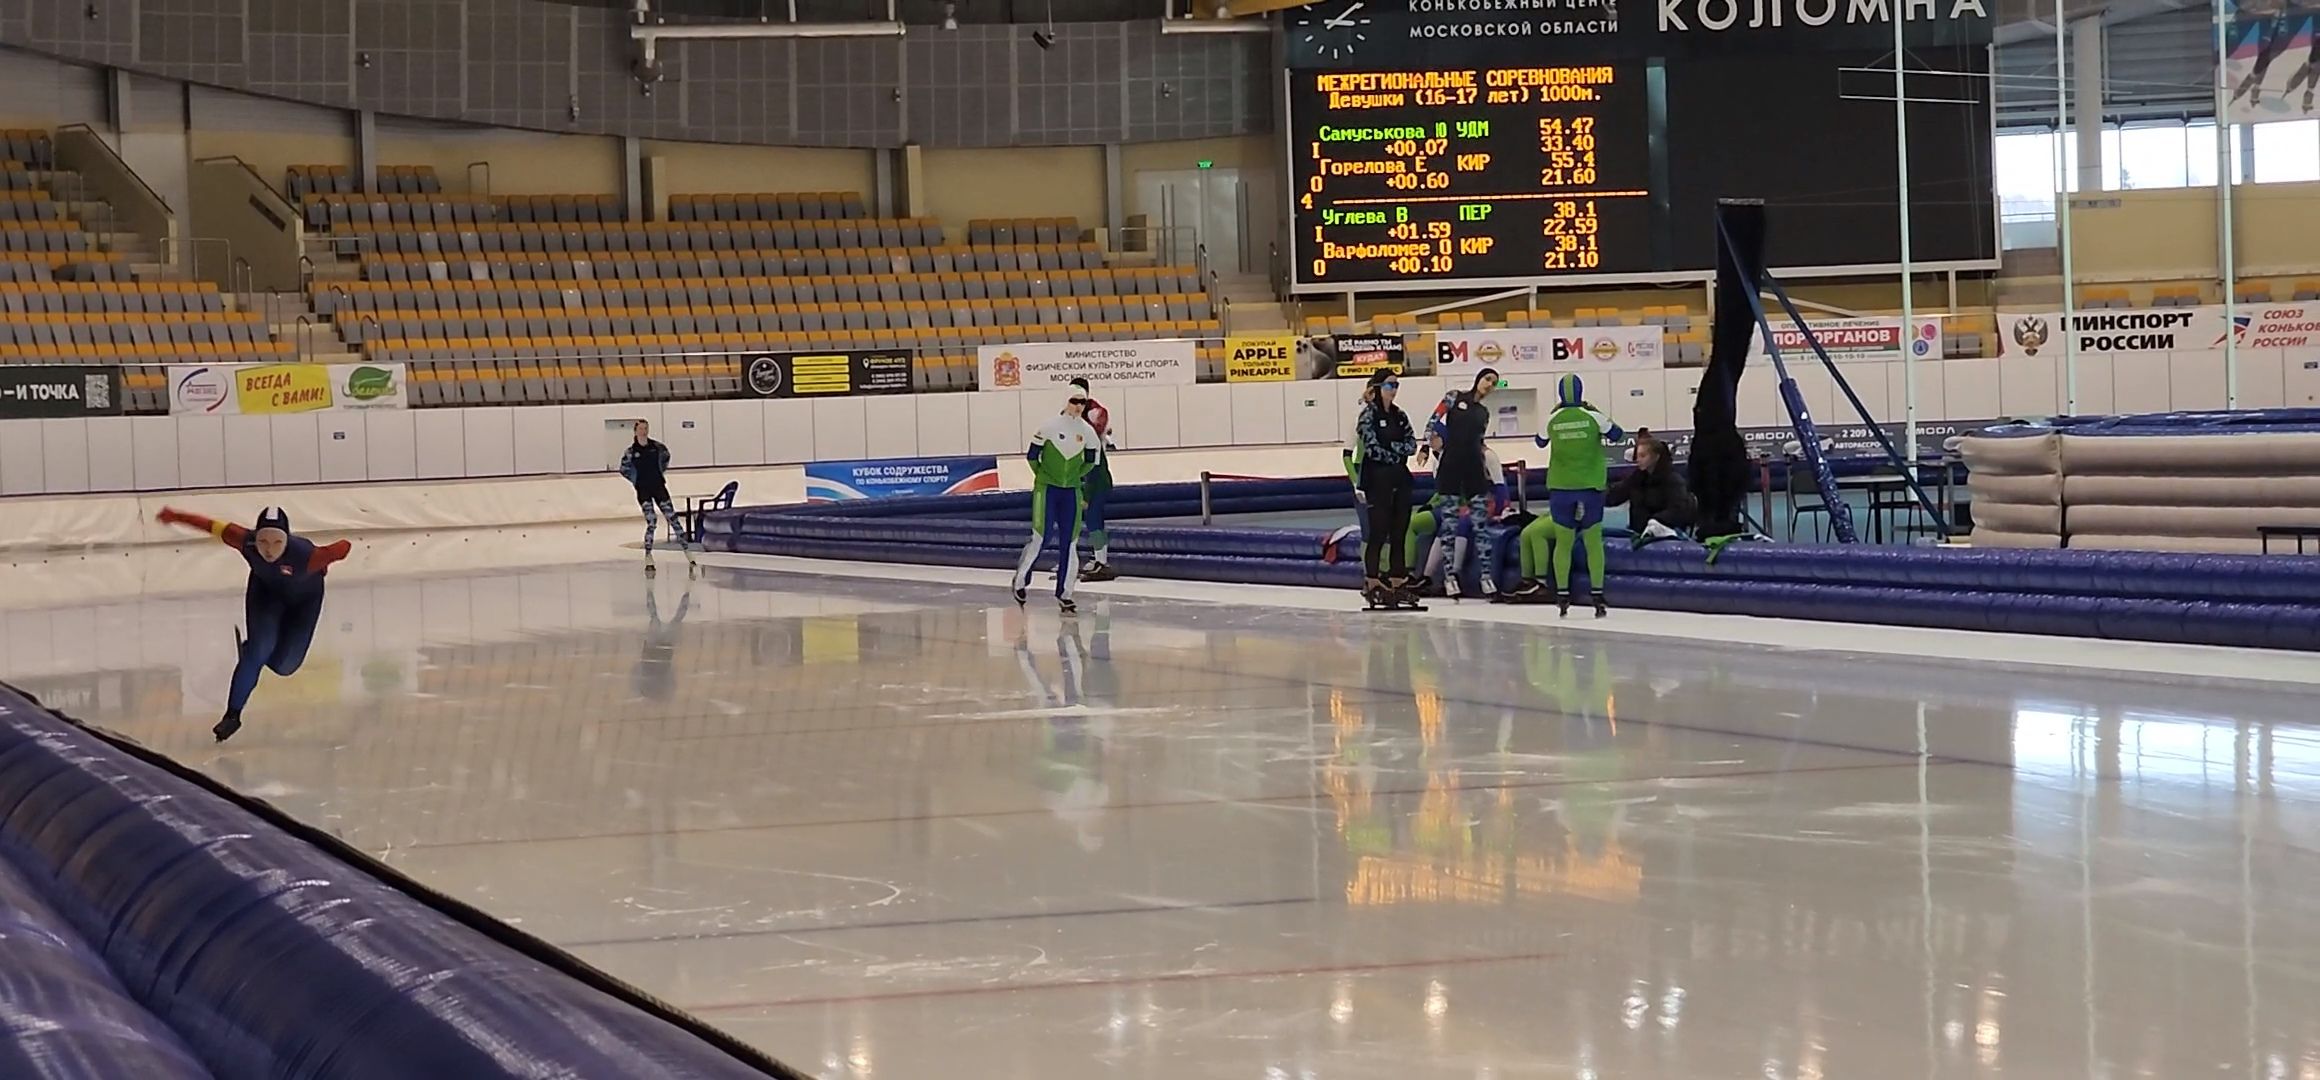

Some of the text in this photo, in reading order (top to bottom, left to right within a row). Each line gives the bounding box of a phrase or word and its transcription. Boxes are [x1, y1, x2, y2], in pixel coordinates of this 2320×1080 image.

[1658, 0, 1987, 32] КОЛОМНА
[1409, 20, 1618, 38] МОСКОВСКОЙ ОБЛАСТИ
[1317, 66, 1613, 92] МЕЖРЕГИОНАЛЬНЫЕ СОРЕВНОВАНИЯ
[1328, 85, 1602, 109] Девушки (16-17 лет) 1000м.
[1318, 117, 1595, 143] Самуськова Ю УДМ 54.47
[1385, 139, 1448, 157] +00.07
[1540, 134, 1595, 152] 33.40
[1319, 158, 1406, 176] Горелова
[1457, 153, 1491, 171] КИР
[1551, 152, 1596, 169] 55.4
[1385, 171, 1450, 190] +00.60
[1541, 168, 1597, 186] 21.60
[1300, 194, 1313, 210] 4
[1322, 208, 1387, 226] Углева
[1459, 204, 1493, 222] ПЕР
[1553, 201, 1598, 218] 38.1
[1387, 221, 1452, 240] +01.59
[1543, 217, 1598, 236] 22.59
[1323, 243, 1431, 260] Варфоломее
[1460, 237, 1494, 254] КИР
[1554, 235, 1598, 252] 38.1
[1388, 255, 1453, 273] +00.10
[1544, 251, 1600, 269] 21.10
[2060, 312, 2194, 332] МИНСПОРТ
[2263, 309, 2304, 320] СОЮЗ
[1813, 329, 1891, 345] ОРГАНОВ
[2080, 333, 2174, 351] РОССИИ
[2252, 336, 2308, 348] РОССИИ
[1065, 350, 1137, 359] МИНИСТЕРСТВО
[1233, 346, 1288, 360] APPLE
[1026, 359, 1179, 371] ФИЗИЧЕСКОЙ КУЛЬТУРЫ И СПОРТА
[1230, 367, 1291, 377] PINEAPPLE
[246, 373, 291, 392] ВСЕГДА
[1113, 371, 1156, 380] ОБЛАСТИ
[16, 384, 27, 400] И
[30, 383, 79, 400] ТОЧКА
[272, 393, 279, 406] С
[282, 387, 324, 406] ВАМИ!
[852, 464, 949, 477] КУБОК СОДРУЖЕСТВА
